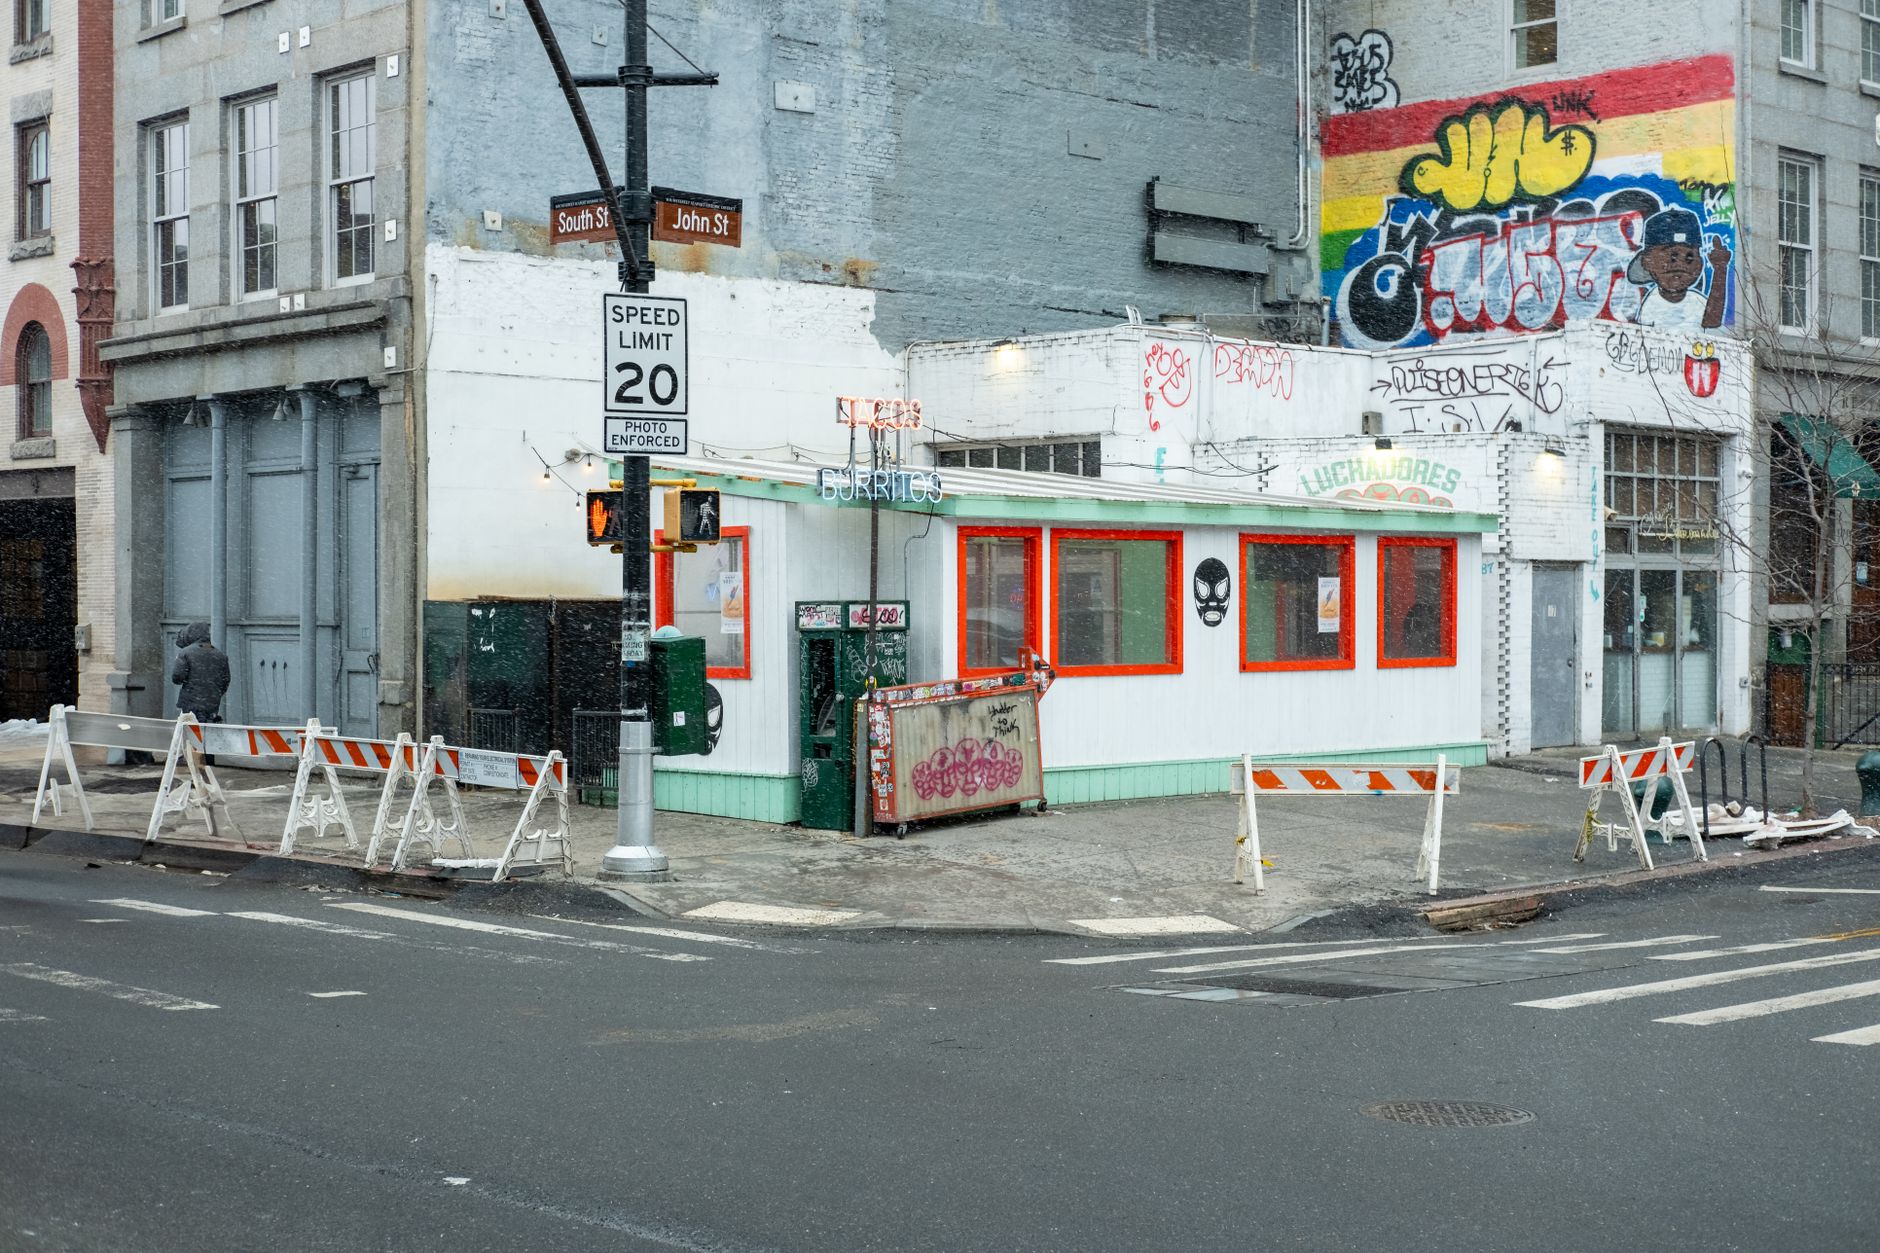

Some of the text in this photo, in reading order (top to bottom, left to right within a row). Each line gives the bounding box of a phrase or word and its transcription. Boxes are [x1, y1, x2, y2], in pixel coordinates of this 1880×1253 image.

[558, 206, 609, 234] South St
[672, 207, 729, 236] John St
[612, 304, 680, 327] SPEED
[619, 331, 673, 351] LIMIT
[615, 361, 679, 407] 20
[839, 395, 923, 431] TACOS
[611, 434, 681, 448] ENFORCED
[625, 421, 668, 434] PHOTO
[821, 468, 944, 504] BURRITOS
[1300, 456, 1462, 498] LUCHADORES
